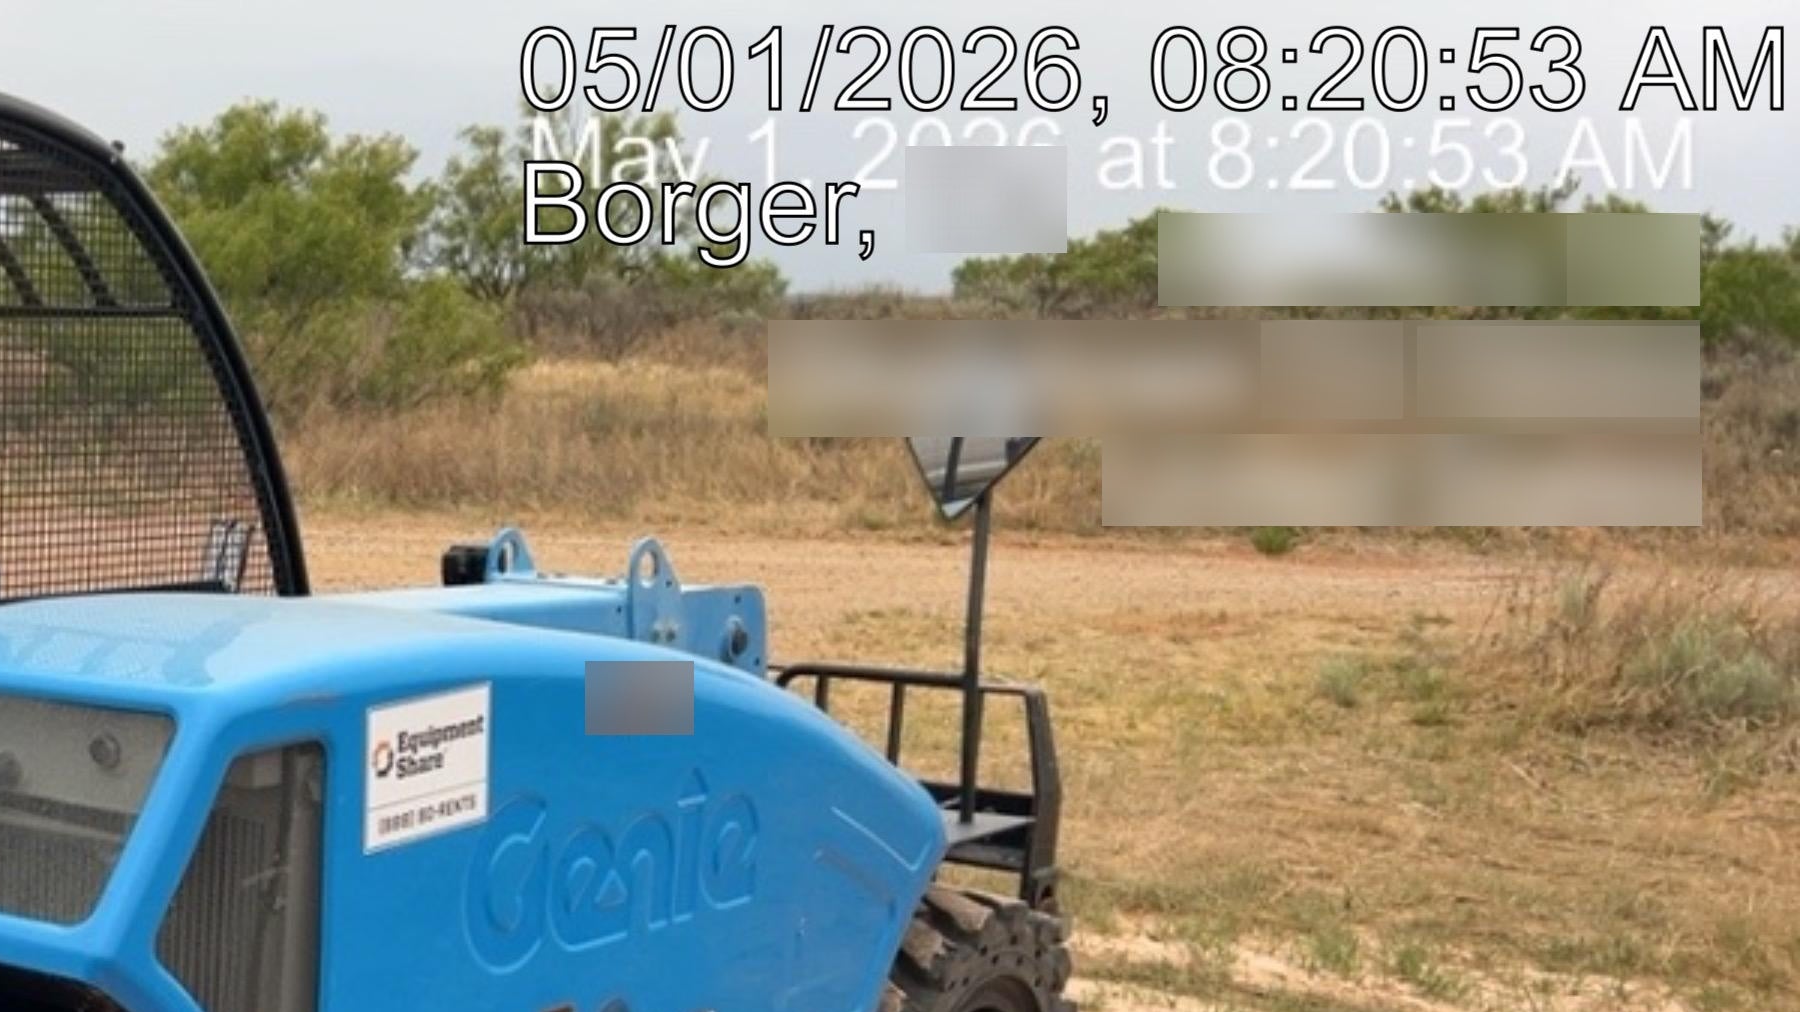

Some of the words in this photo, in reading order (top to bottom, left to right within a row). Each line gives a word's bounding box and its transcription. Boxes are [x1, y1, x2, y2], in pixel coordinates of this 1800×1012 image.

[397, 714, 484, 753] Equipment
[396, 752, 444, 779] Share
[461, 767, 760, 975] Genie
